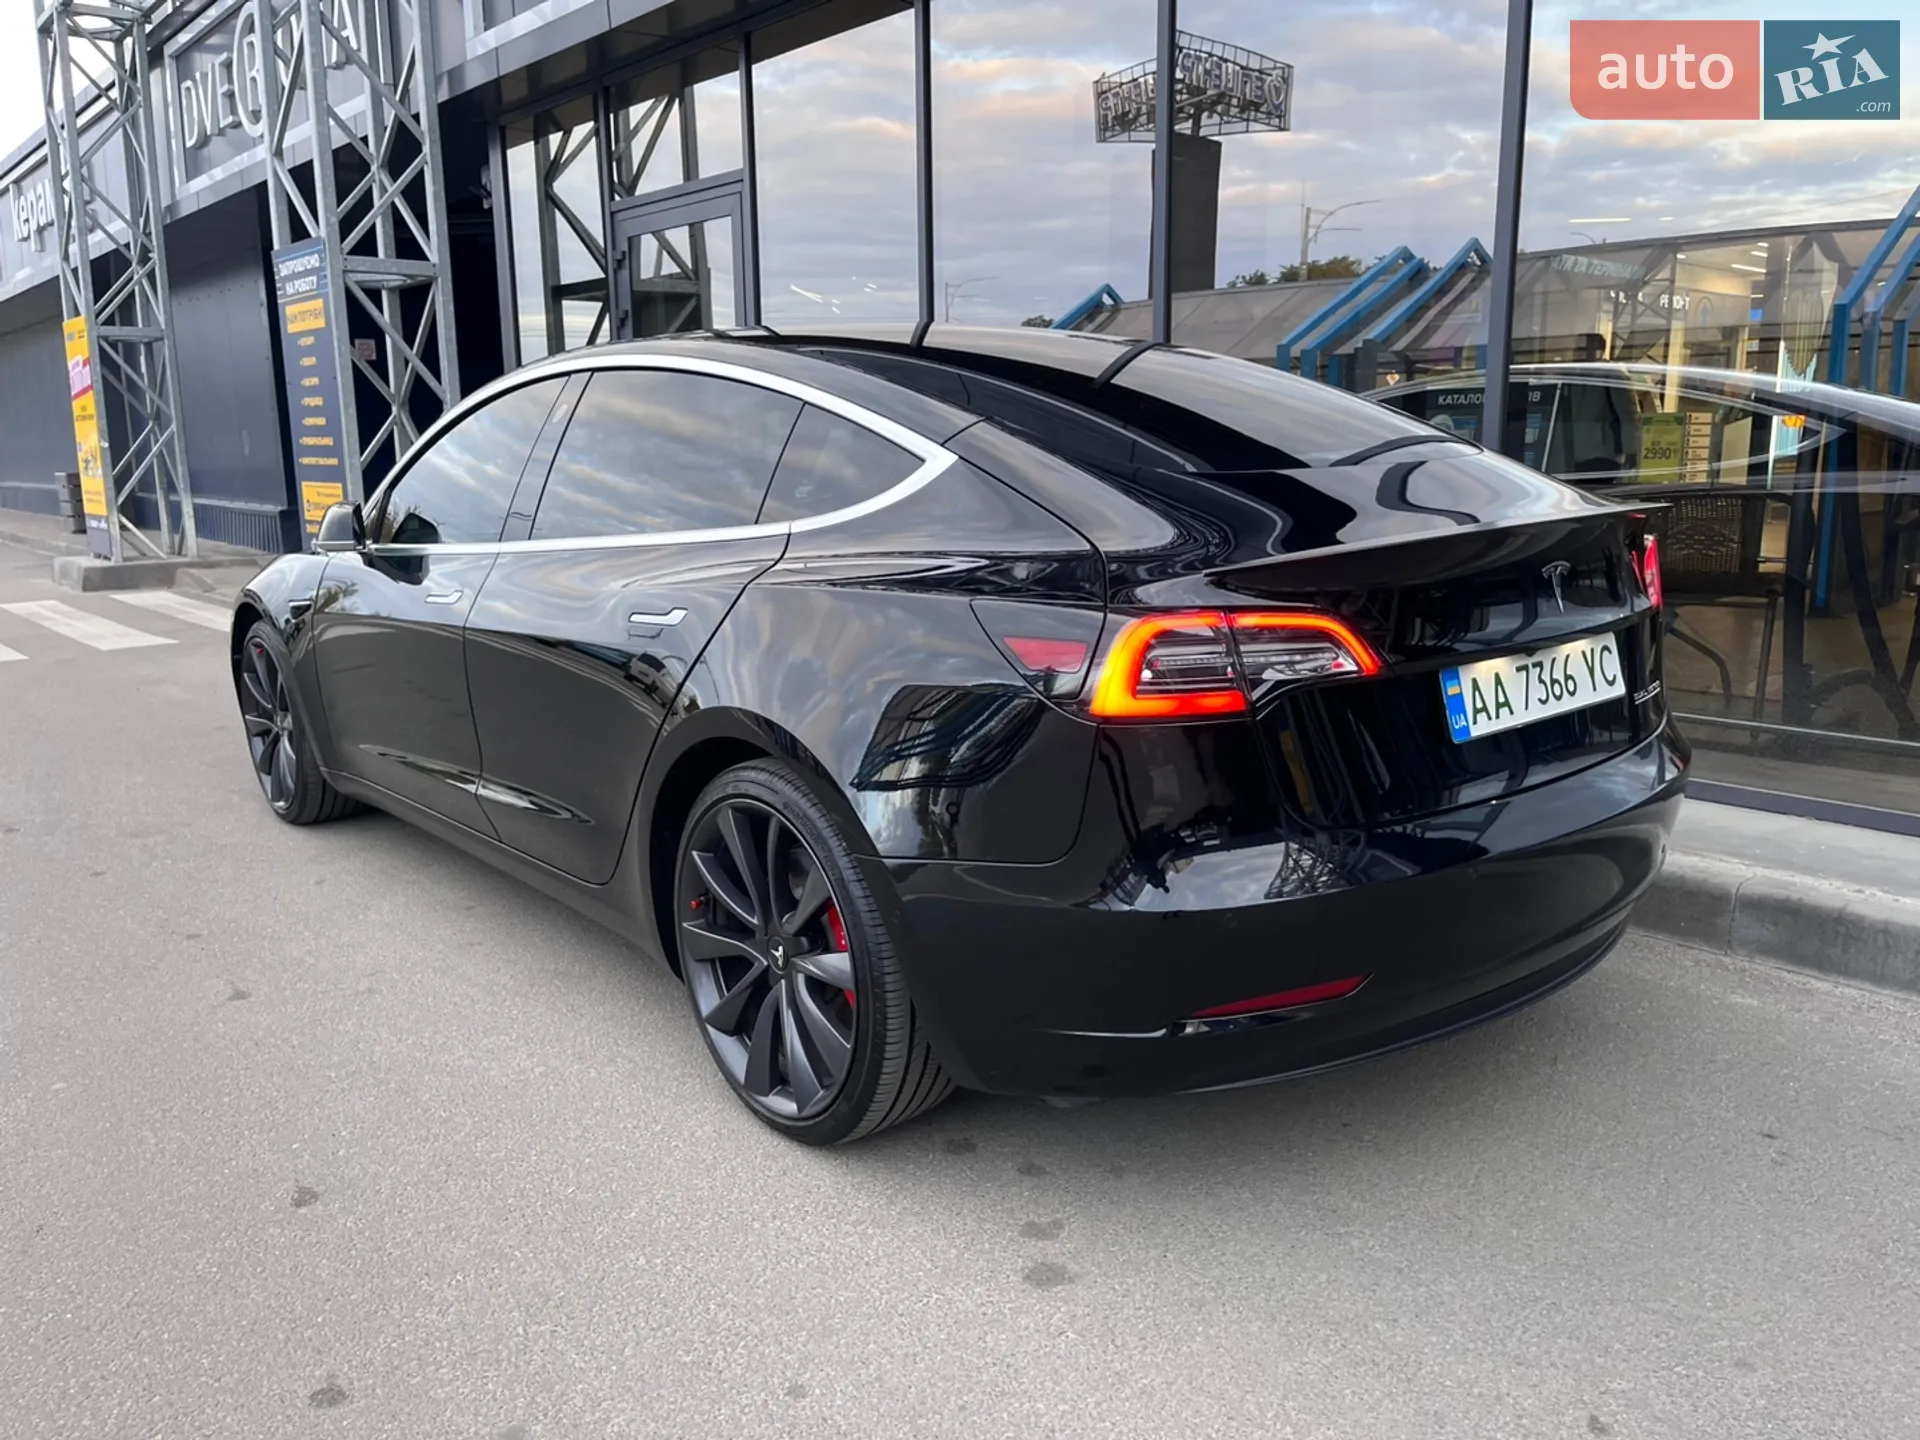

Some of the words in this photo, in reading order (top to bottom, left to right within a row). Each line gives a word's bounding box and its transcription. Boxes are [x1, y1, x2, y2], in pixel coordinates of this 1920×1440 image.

[1438, 393, 1485, 405] КАТАЛО
[1643, 447, 1671, 460] 2990
[1471, 671, 1515, 726] AA
[1515, 653, 1577, 711] 7366
[1581, 644, 1617, 692] YC
[1451, 713, 1468, 729] UA
